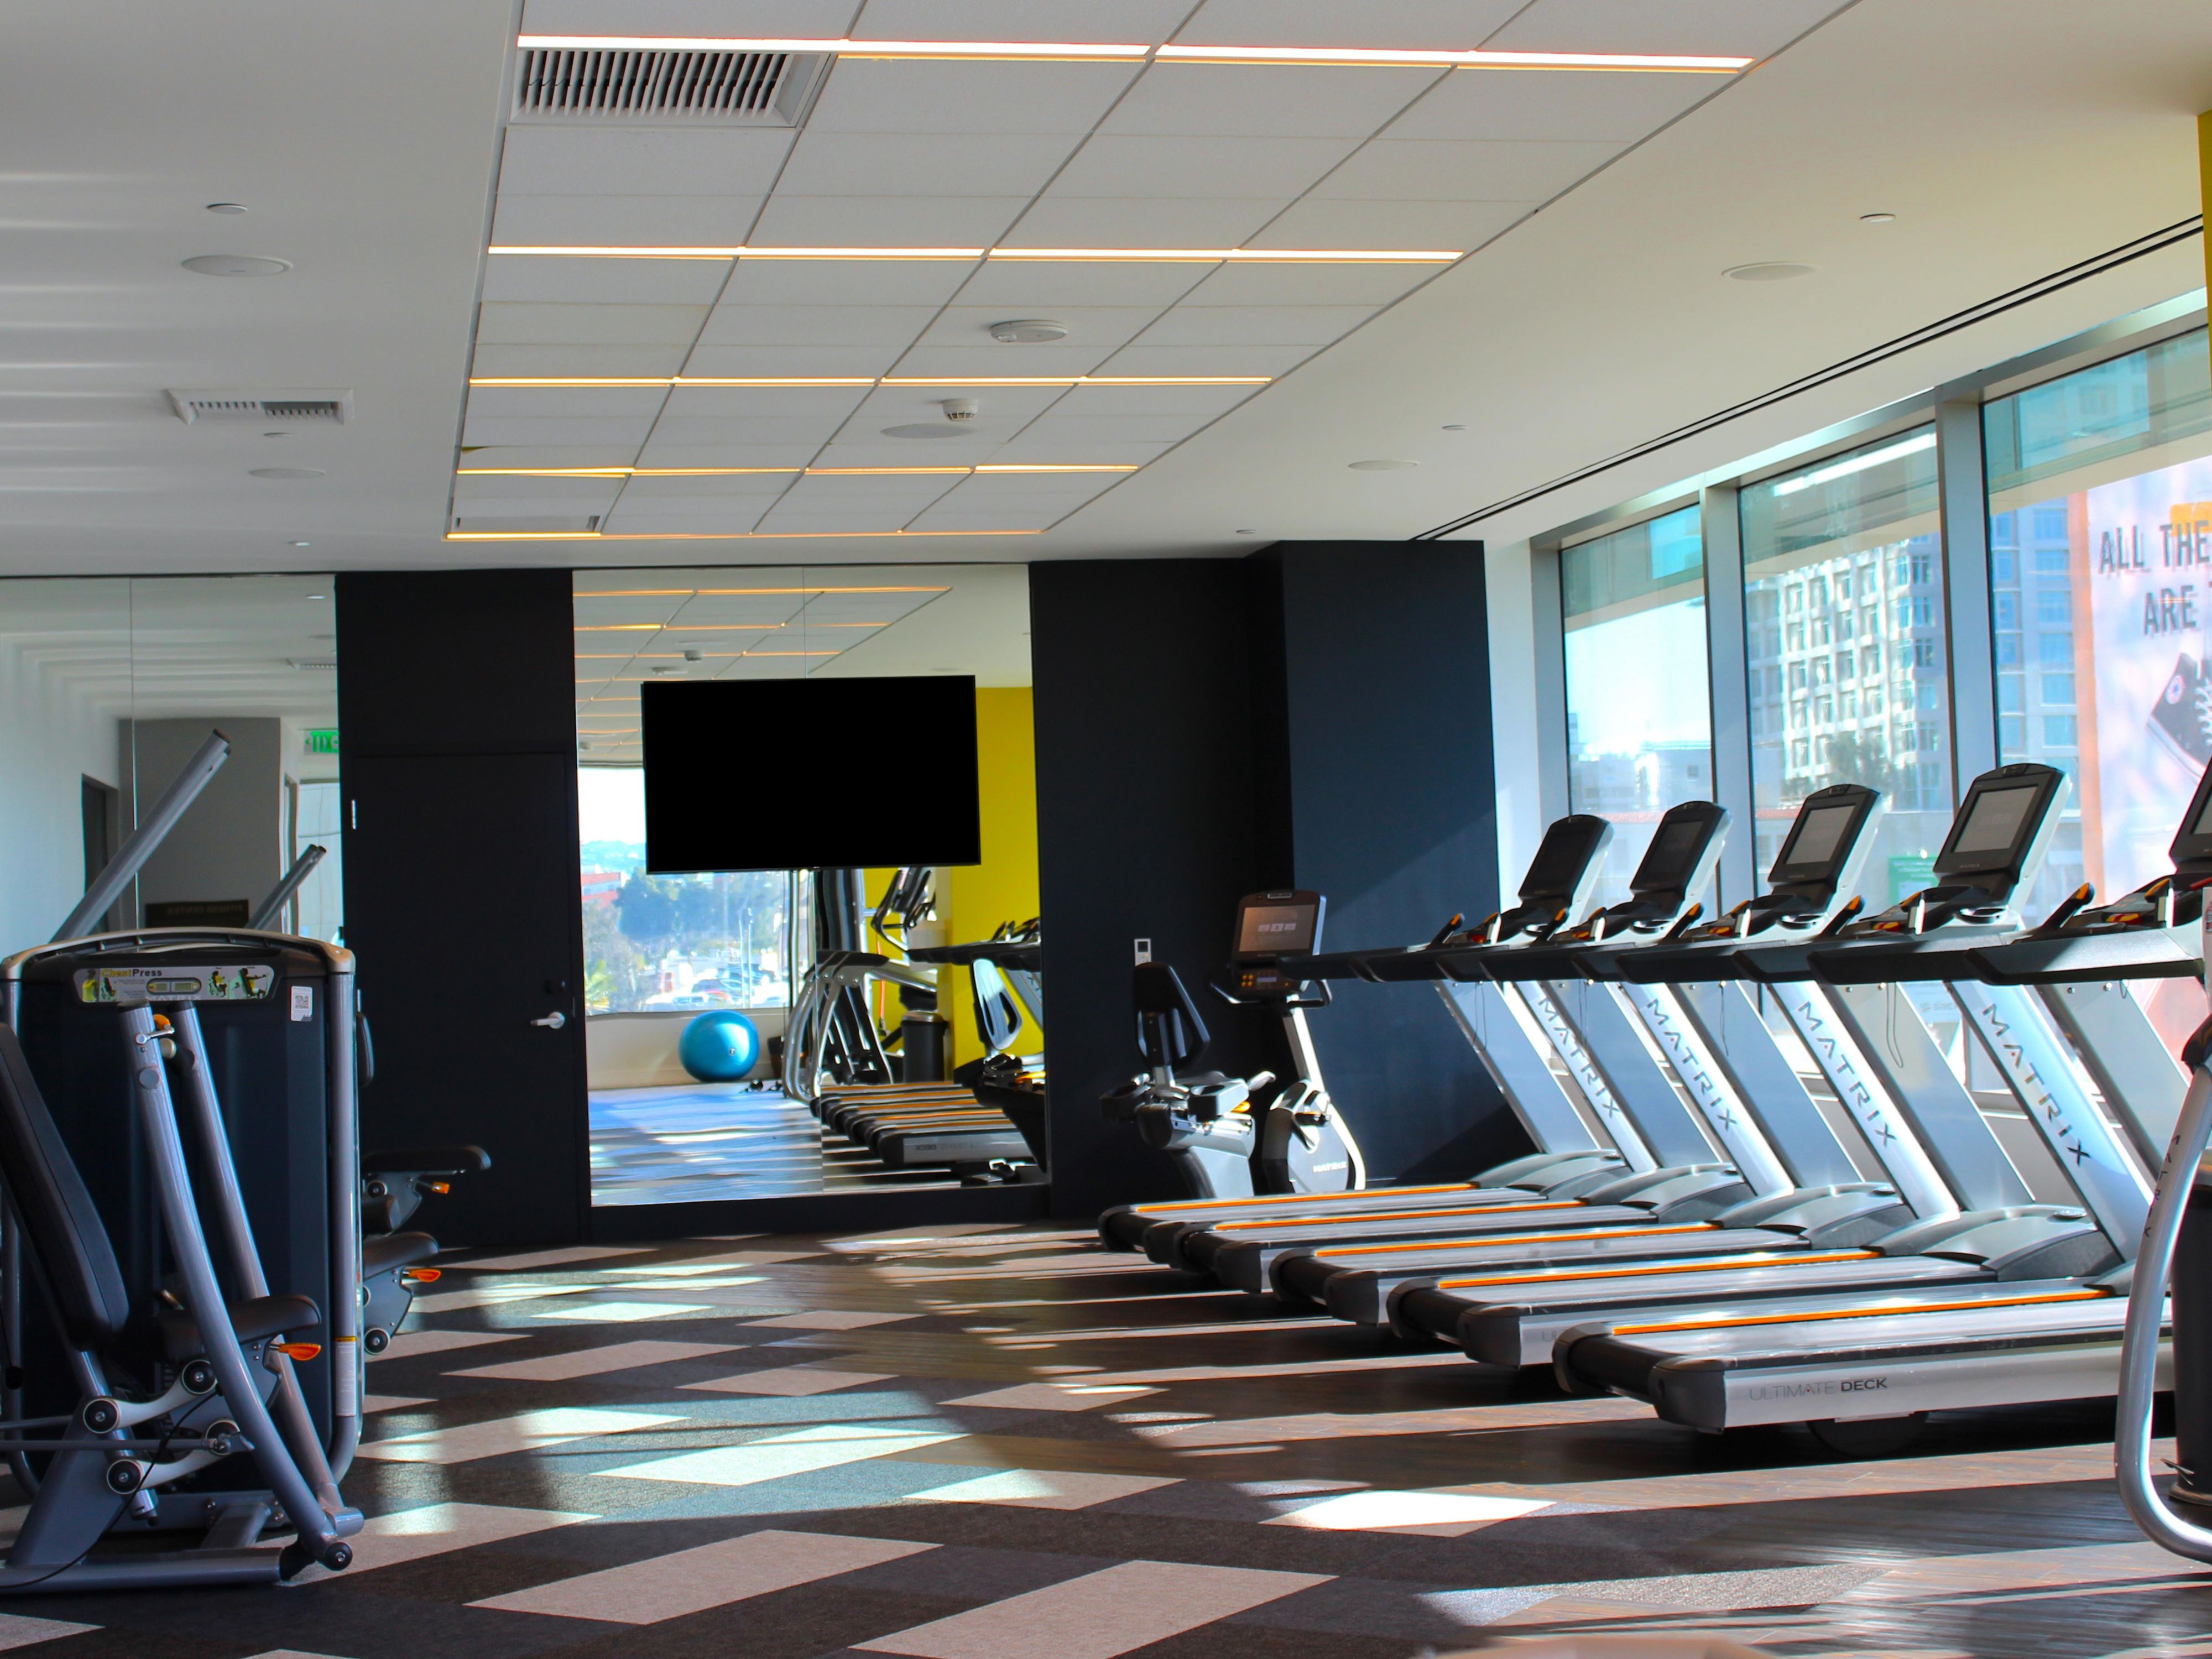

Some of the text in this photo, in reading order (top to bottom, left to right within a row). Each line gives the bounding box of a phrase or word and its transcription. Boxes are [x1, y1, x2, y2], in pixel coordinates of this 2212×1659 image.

[2099, 520, 2210, 574] ALL THE
[2143, 585, 2197, 635] ARE
[1537, 997, 1620, 1118] MATRIX
[1646, 999, 1738, 1131] MATRIX
[1797, 1001, 1896, 1148] MATRIX
[1982, 1004, 2090, 1167] MATRIX
[1313, 1161, 1347, 1173] MATRIX
[1749, 1378, 1888, 1401] ULTIMATE DECK
